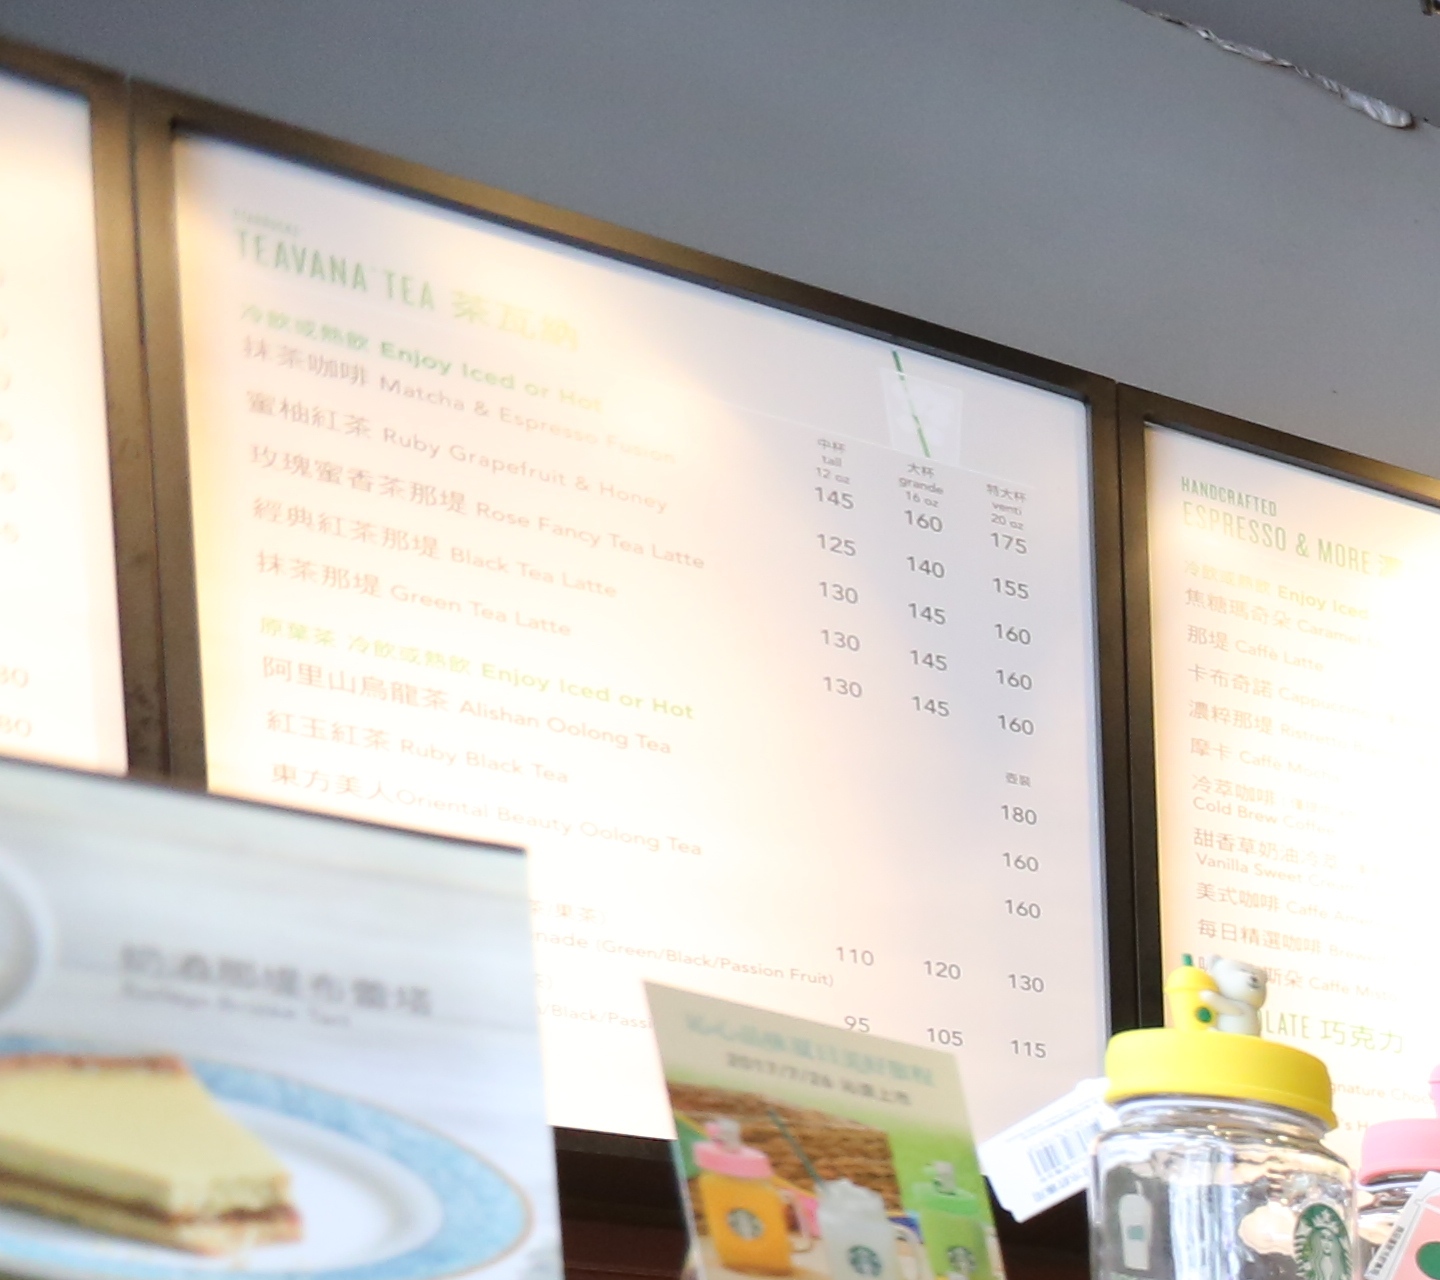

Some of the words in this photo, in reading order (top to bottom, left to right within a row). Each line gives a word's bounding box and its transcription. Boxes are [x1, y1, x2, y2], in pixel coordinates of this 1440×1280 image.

[386, 270, 436, 310] TEA
[380, 340, 453, 377] Enjoy
[463, 363, 515, 390] Iced
[243, 335, 368, 387] 抹茶咖啡
[380, 374, 465, 411] Matcha
[474, 399, 490, 416] &
[499, 406, 598, 447] Espresso
[248, 391, 372, 439] 蜜柚紅茶
[383, 427, 441, 459] Ruby
[451, 444, 566, 488] Grapefruit
[575, 475, 590, 492] &
[599, 480, 669, 514] Honey
[250, 445, 468, 516] 玫瑰蜜香茶那堤
[477, 500, 529, 529] Rose
[538, 516, 601, 548] Fancy
[608, 532, 645, 555] Tea
[652, 543, 706, 571] Latte
[813, 485, 856, 512] 145
[904, 507, 944, 536] 160
[989, 531, 1029, 556] 175
[1180, 476, 1278, 518] HANDCRAFTED
[253, 498, 441, 560] 經典紅茶那堤
[451, 546, 509, 576] Black
[517, 562, 554, 585] Tea
[562, 571, 618, 599] Latte
[1182, 500, 1287, 552] ESPRESSO
[1295, 531, 1310, 559] &
[1317, 537, 1371, 575] MORE
[815, 533, 857, 558] 125
[905, 554, 947, 581] 140
[992, 577, 1031, 602] 155
[256, 549, 382, 599] 抹茶那堤
[391, 584, 463, 614] Green
[469, 600, 508, 624] Tea
[514, 610, 572, 638] Latte
[817, 580, 860, 606] 130
[907, 601, 949, 627] 145
[993, 622, 1033, 647] 160
[1184, 587, 1291, 630] 焦糖瑪奇朵
[1277, 584, 1327, 613] Enjoy
[1332, 599, 1370, 620] Iced
[819, 628, 862, 653] 130
[909, 648, 950, 674] 145
[994, 667, 1034, 692] 160
[1187, 624, 1229, 653] 那堤
[1283, 651, 1325, 673] Latte
[261, 655, 449, 713] 阿里山烏龍茶
[458, 698, 541, 731] Alishan
[547, 715, 630, 751] Oolong
[635, 731, 672, 755] Tea
[481, 661, 550, 695] Enjoy
[559, 678, 611, 704] Iced
[652, 699, 695, 722] Hot
[1187, 663, 1273, 699] 卡布奇諾
[821, 675, 864, 700] 130
[911, 694, 952, 720] 145
[997, 713, 1036, 738] 160
[266, 709, 391, 754] 紅玉紅茶
[401, 735, 457, 767] Ruby
[466, 750, 525, 778] Black
[532, 761, 569, 784] Tea
[1190, 736, 1233, 761] 摩卡
[271, 762, 394, 805] 東方美人
[396, 784, 489, 820] Oriental
[498, 805, 572, 838] Beauty
[579, 818, 660, 853] Oolong
[667, 835, 703, 857] Tea
[1000, 803, 1039, 827] 180
[1192, 795, 1232, 816] Cold
[1237, 805, 1278, 825] Brew
[1001, 850, 1041, 875] 160
[1195, 851, 1249, 875] Vanilla
[1253, 863, 1303, 884] Sweet
[1004, 898, 1043, 921] 160
[1196, 881, 1281, 914] 美式咖啡
[834, 945, 876, 969] 110
[922, 959, 962, 983] 120
[1006, 972, 1046, 995] 130
[844, 1014, 871, 1034] 95
[926, 1025, 965, 1049] 105
[1009, 1038, 1048, 1060] 115
[1320, 1018, 1403, 1055] 巧克力
